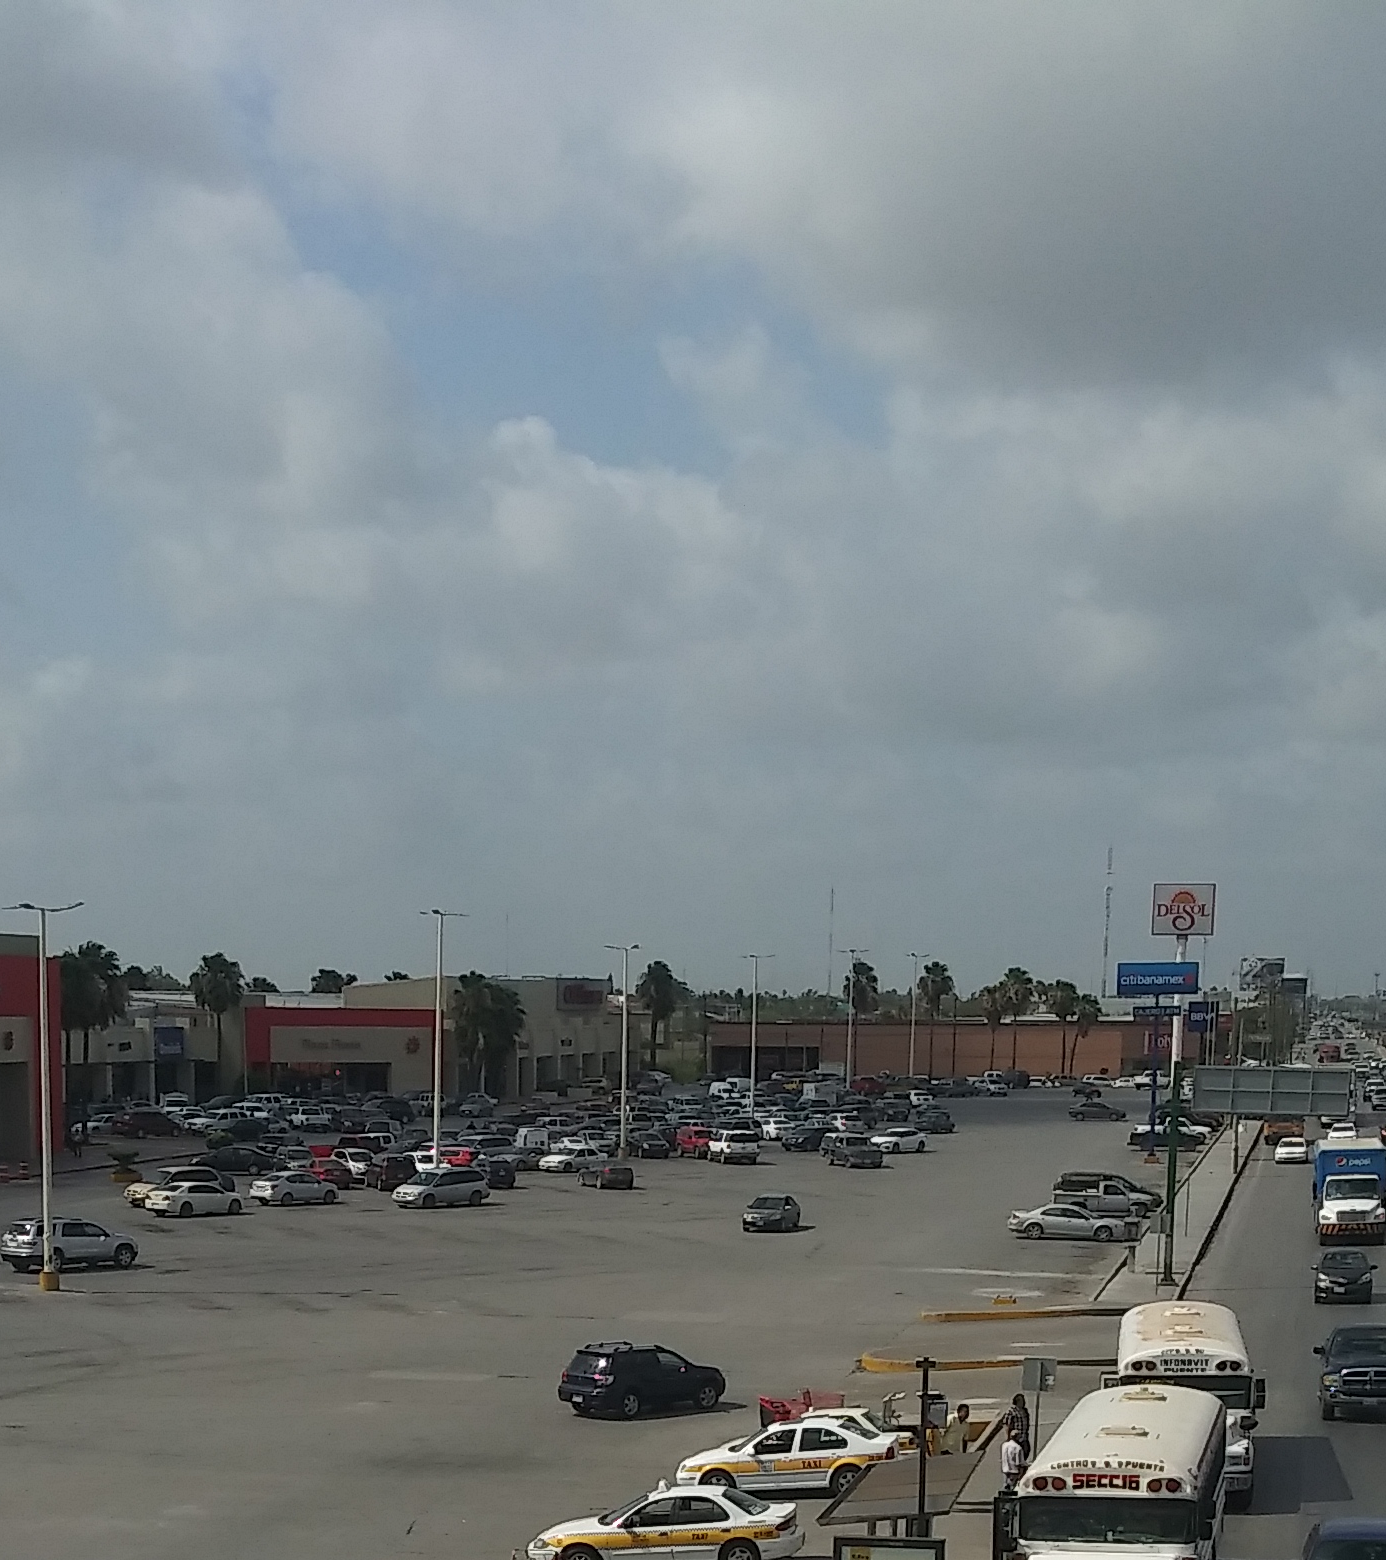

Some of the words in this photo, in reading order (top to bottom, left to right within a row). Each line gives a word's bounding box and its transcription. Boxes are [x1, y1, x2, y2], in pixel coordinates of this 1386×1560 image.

[1120, 973, 1185, 985] citibanamex
[1348, 1157, 1371, 1167] pepsi
[1160, 1358, 1210, 1366] INFONAVIT
[801, 1459, 823, 1469] TAXI
